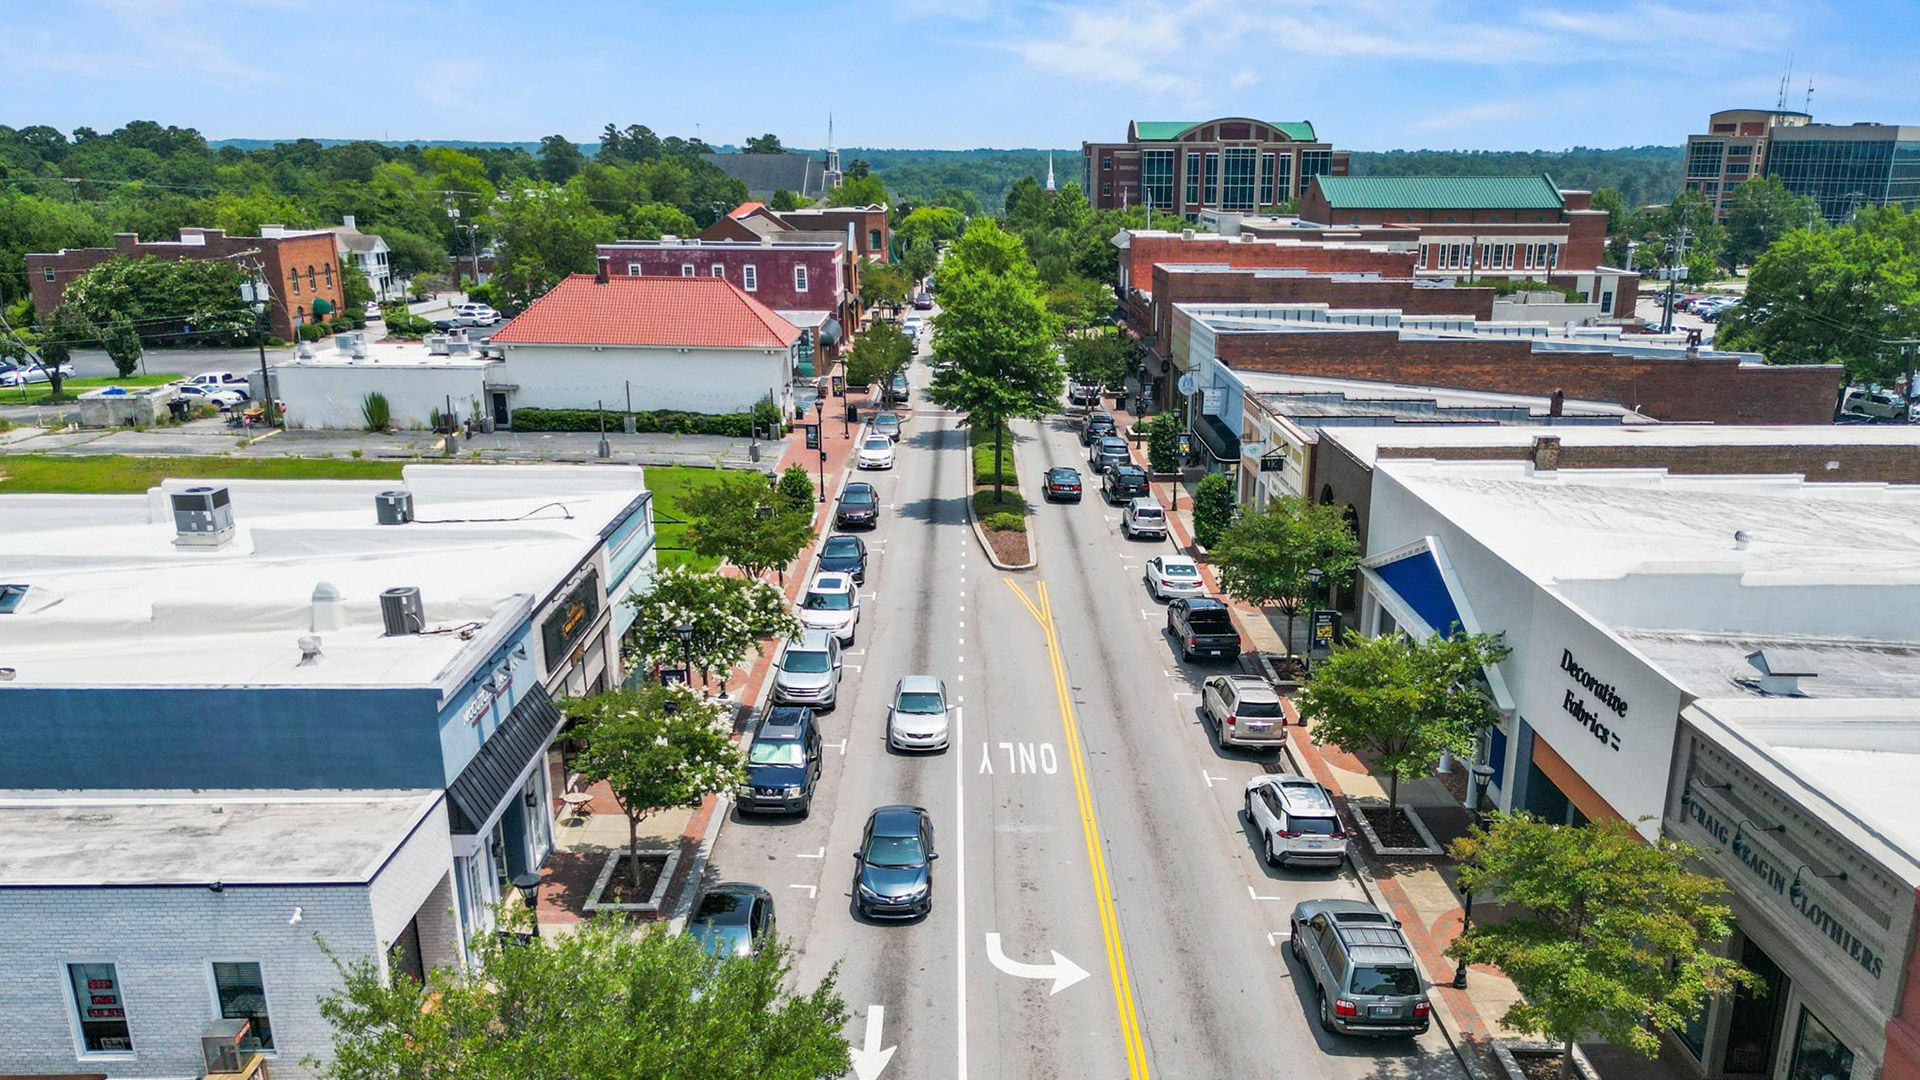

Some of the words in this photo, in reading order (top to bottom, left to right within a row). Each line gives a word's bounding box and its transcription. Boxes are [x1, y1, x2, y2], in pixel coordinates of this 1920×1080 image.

[1560, 648, 1628, 718] Decorative
[1562, 688, 1610, 745] Fabrics
[979, 742, 1058, 774] ONLY
[1690, 801, 1729, 845] CRAIG
[1789, 884, 1884, 980] CLOTHIERS
